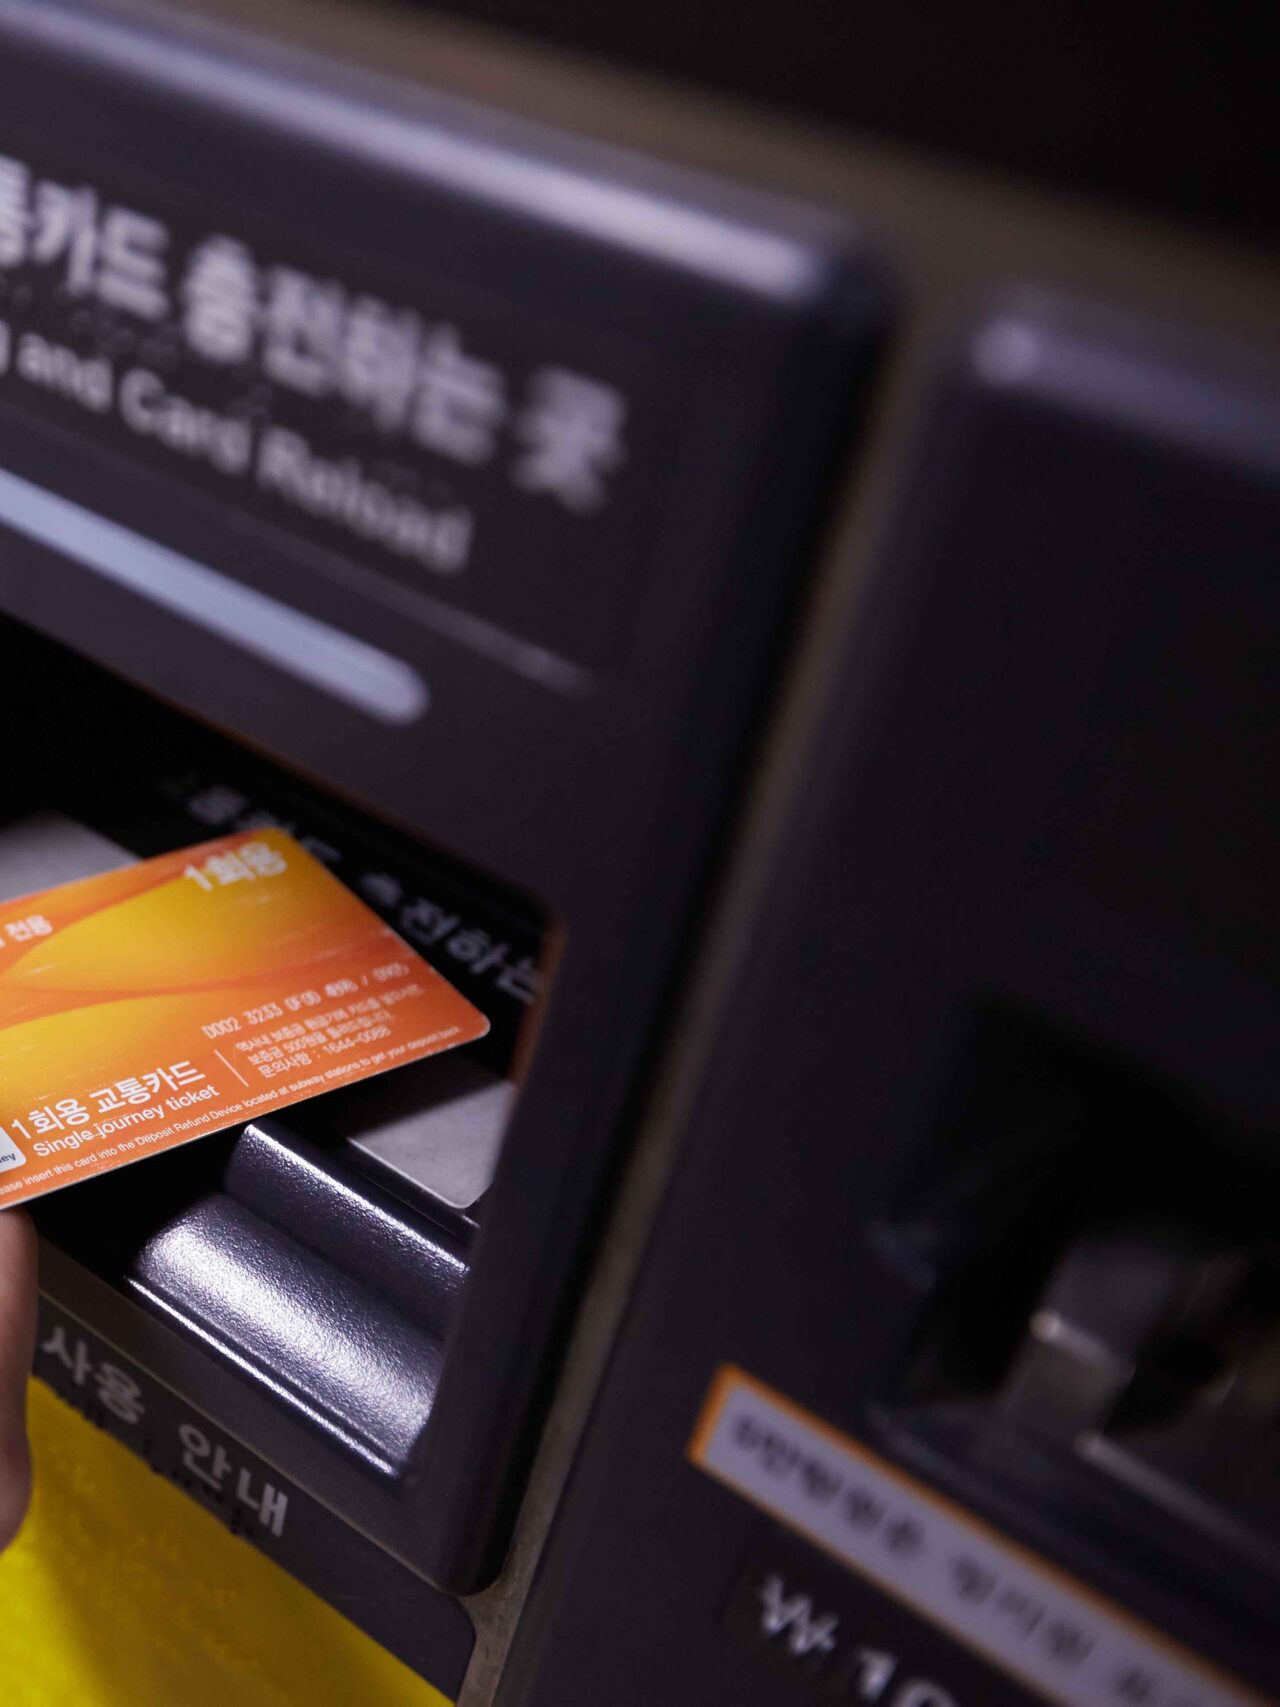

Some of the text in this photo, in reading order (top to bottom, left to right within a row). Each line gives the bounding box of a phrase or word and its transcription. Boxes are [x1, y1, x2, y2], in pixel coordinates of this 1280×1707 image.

[17, 330, 113, 410] and
[120, 368, 252, 475] Card
[184, 842, 287, 892] 1회용
[5, 915, 53, 942] 전용
[11, 1060, 205, 1139] 1회용 교통카드
[23, 1168, 54, 1185] insert
[52, 1163, 74, 1175] this
[73, 1153, 98, 1168] card
[97, 1147, 119, 1159] into
[117, 1141, 136, 1153] the
[133, 1127, 175, 1146] Deposit
[172, 1113, 211, 1132] Refund
[208, 1103, 243, 1120] Device
[241, 1089, 279, 1108] located
[277, 1086, 290, 1096] at
[288, 1075, 325, 1092] subway
[324, 1062, 361, 1079] stations
[358, 1058, 372, 1067] to
[370, 1052, 386, 1064] get
[386, 1045, 407, 1059] your
[32, 1084, 220, 1157] Single journey ticket
[40, 1326, 289, 1537] 사용 안내
